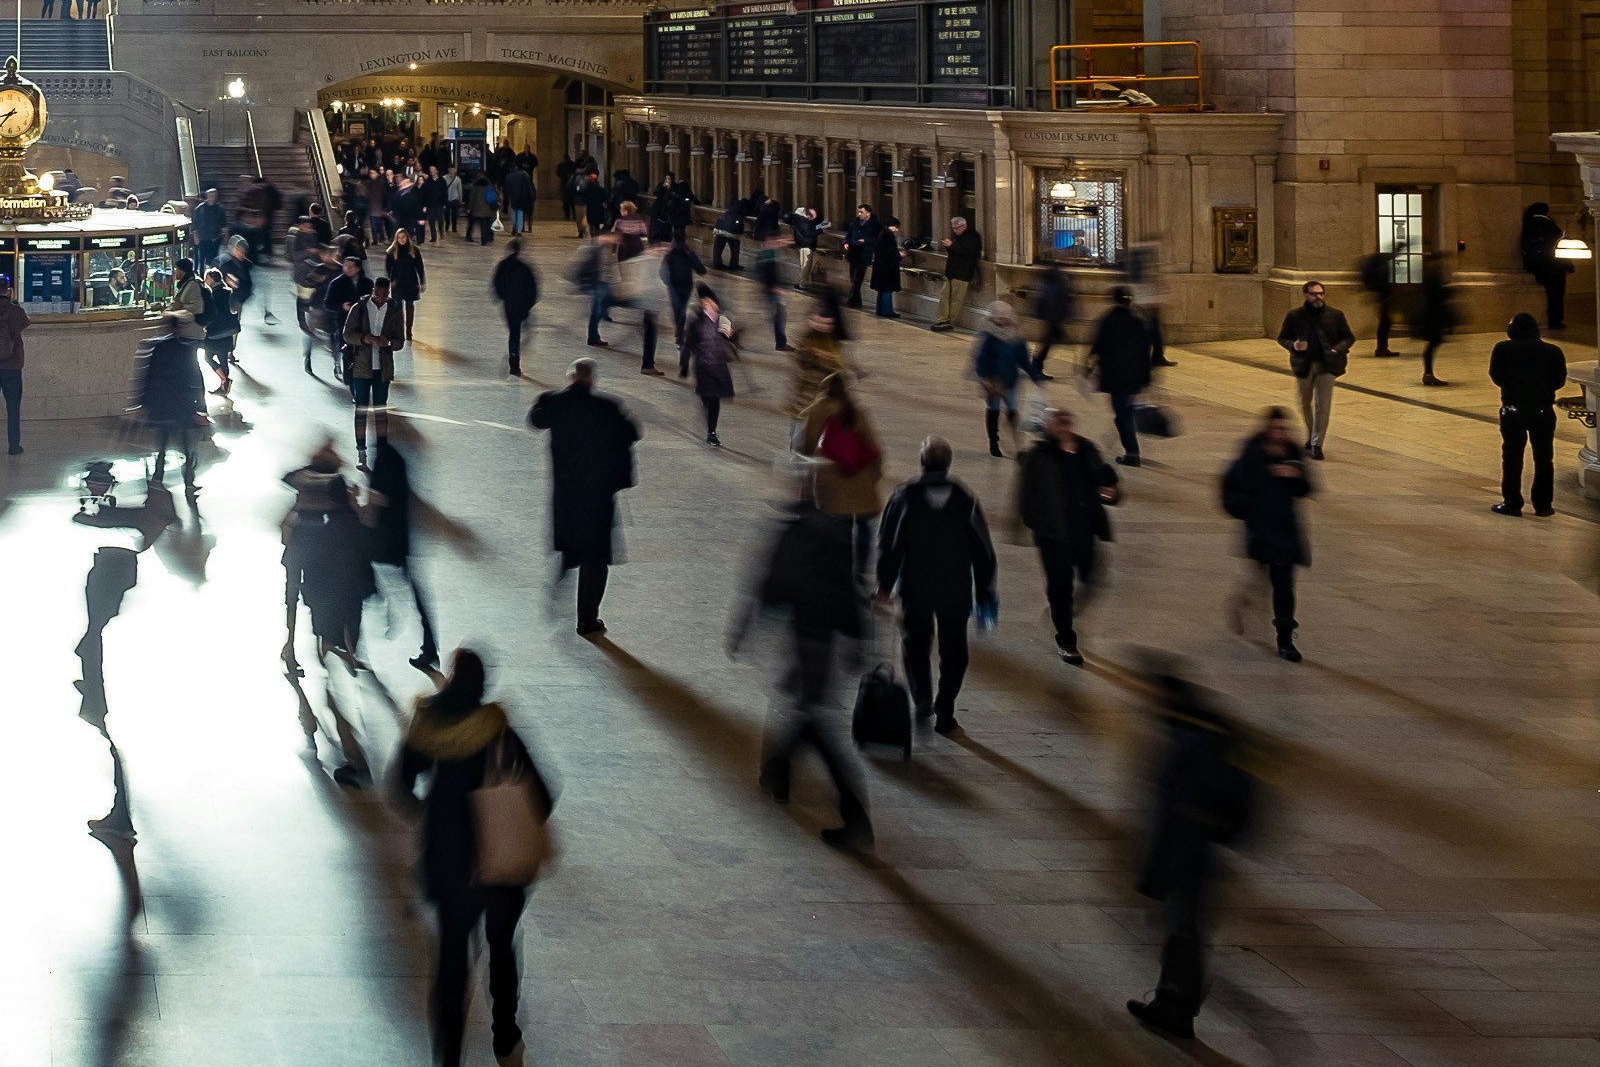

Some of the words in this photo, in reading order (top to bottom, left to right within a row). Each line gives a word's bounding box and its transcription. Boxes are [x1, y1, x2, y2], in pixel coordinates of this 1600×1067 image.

[203, 49, 224, 57] EAST
[227, 49, 269, 57] BALCONY
[360, 50, 431, 72] LEXINGTON
[435, 48, 457, 59] AVE
[501, 48, 543, 60] TICKET
[547, 54, 609, 75] MACHINES
[332, 87, 369, 98] STREET
[372, 85, 415, 94] PASSAGE
[420, 85, 463, 96] SUBWAY
[1024, 132, 1073, 141] CUSTOMER
[1076, 133, 1119, 142] SERVICE
[41, 135, 73, 144] DINING
[75, 138, 122, 157] CONCOURSE
